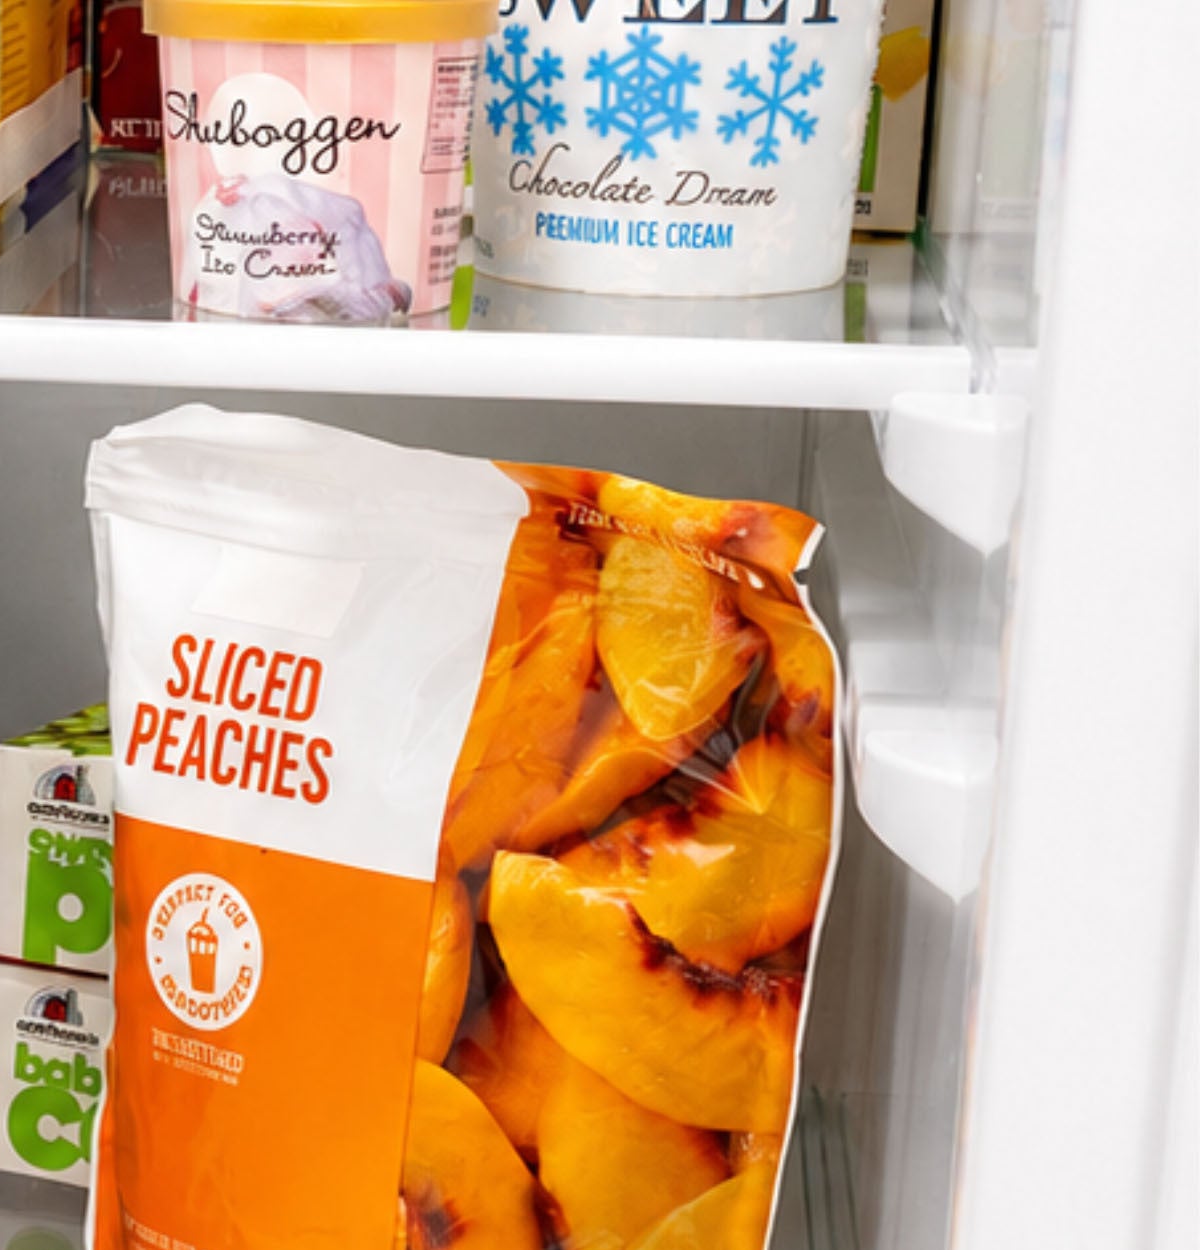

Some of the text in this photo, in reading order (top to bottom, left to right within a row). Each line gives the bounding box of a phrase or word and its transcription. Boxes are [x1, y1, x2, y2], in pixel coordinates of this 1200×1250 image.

[509, 141, 655, 206] Chocolate
[627, 219, 658, 248] ICE
[665, 221, 734, 249] CREAM
[166, 633, 323, 723] SLICED
[125, 701, 334, 805] PEACHES
[14, 1041, 102, 1097] bab
